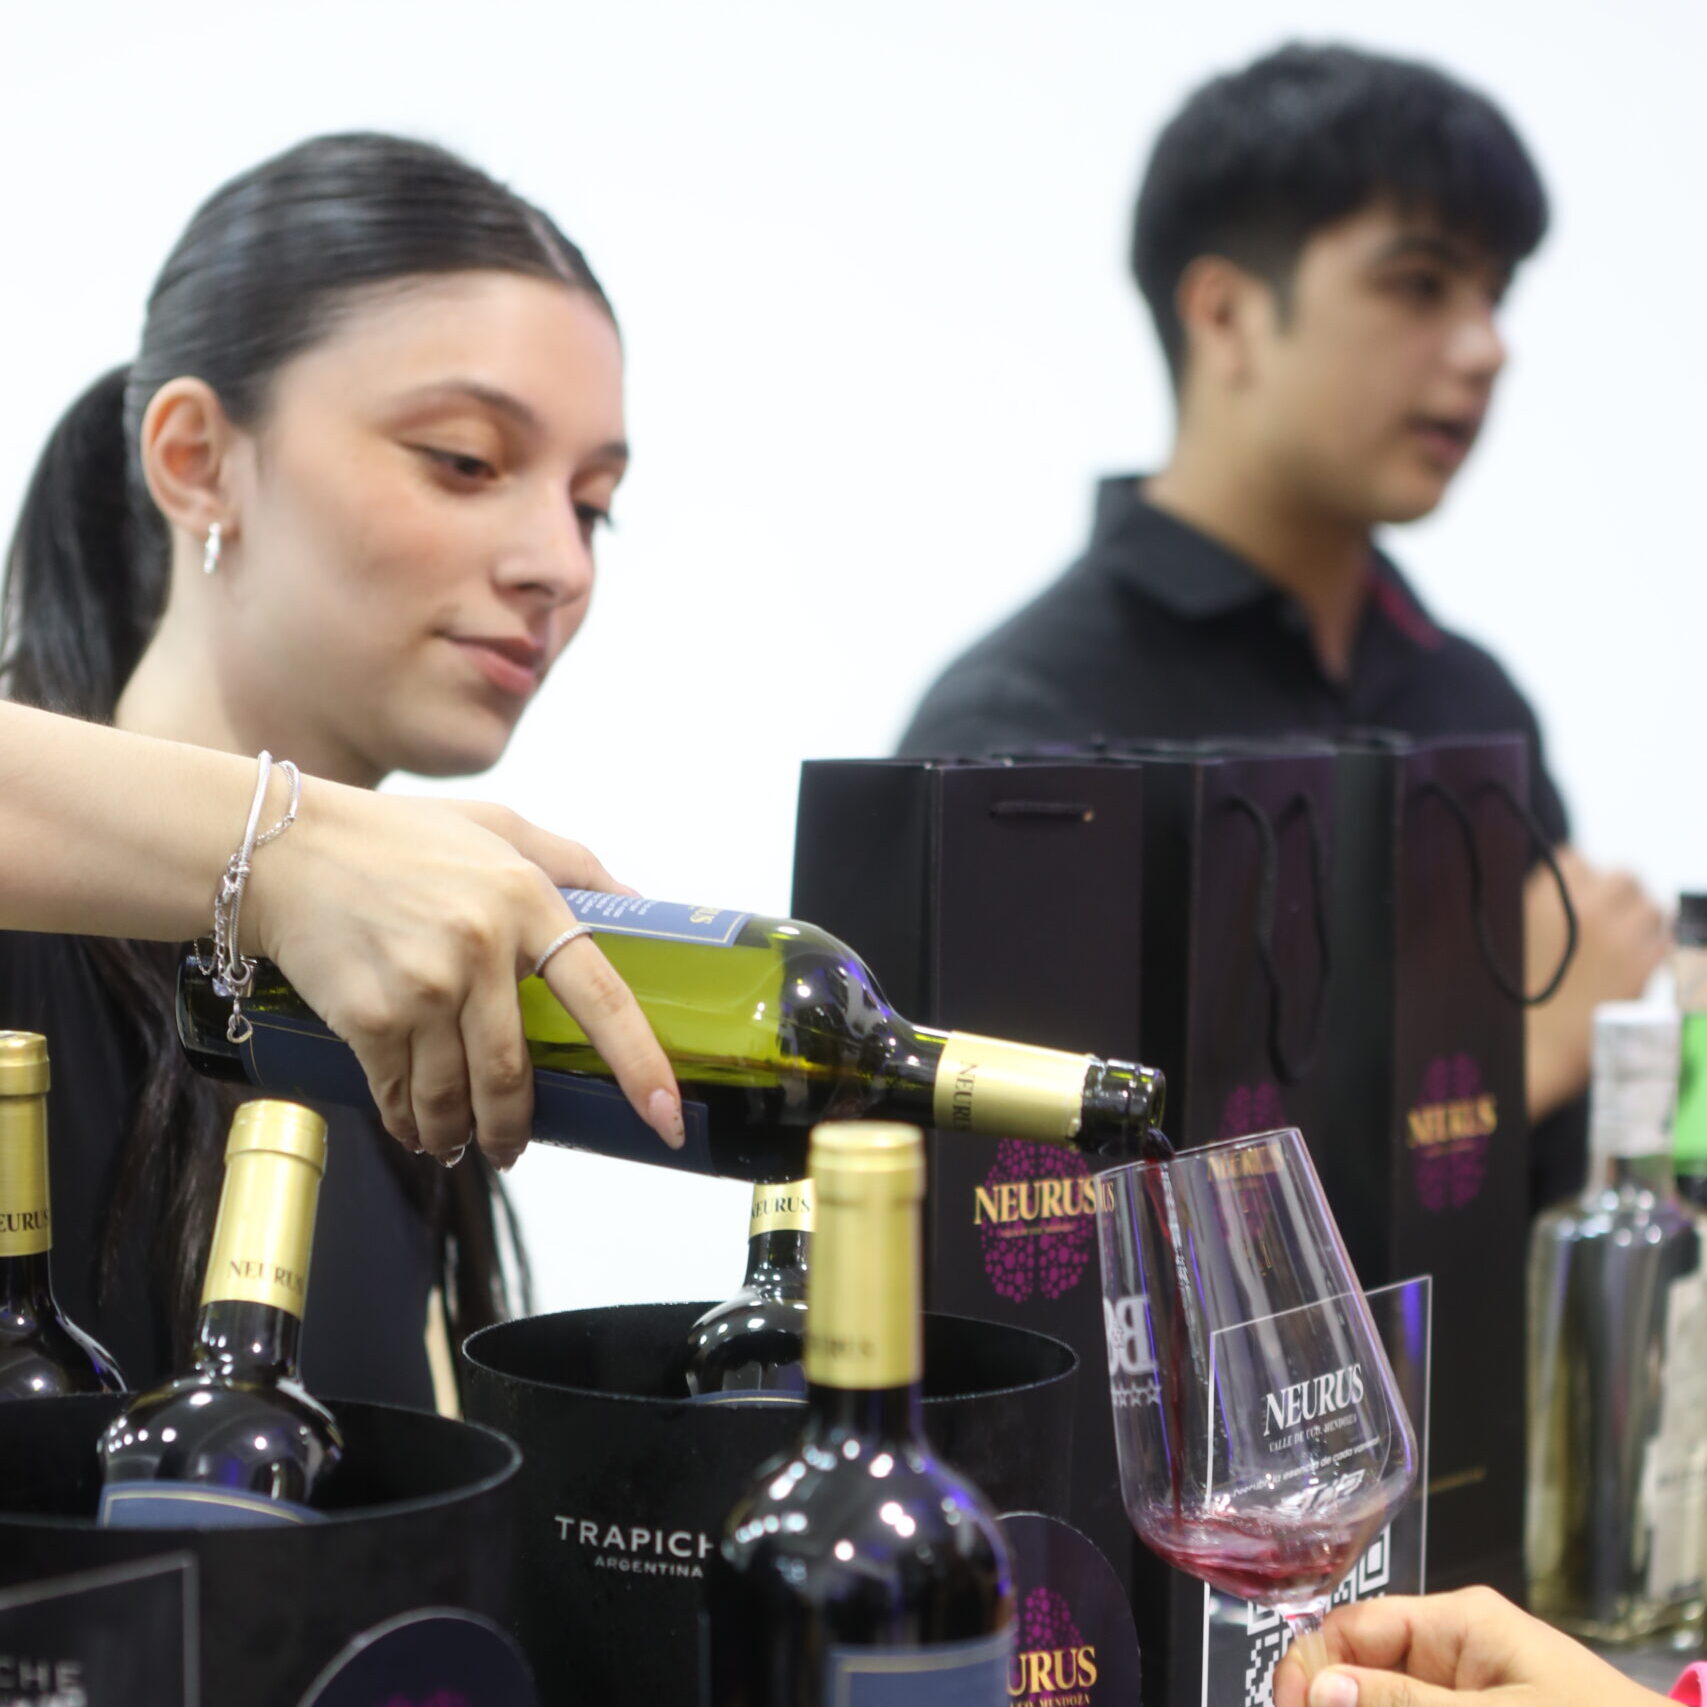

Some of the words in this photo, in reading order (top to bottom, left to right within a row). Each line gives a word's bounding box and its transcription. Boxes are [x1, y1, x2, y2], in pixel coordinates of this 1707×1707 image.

[973, 1175, 1097, 1226] NEURUS
[1263, 1363, 1365, 1437] NEURUS
[594, 1555, 705, 1579] ARGENTINA
